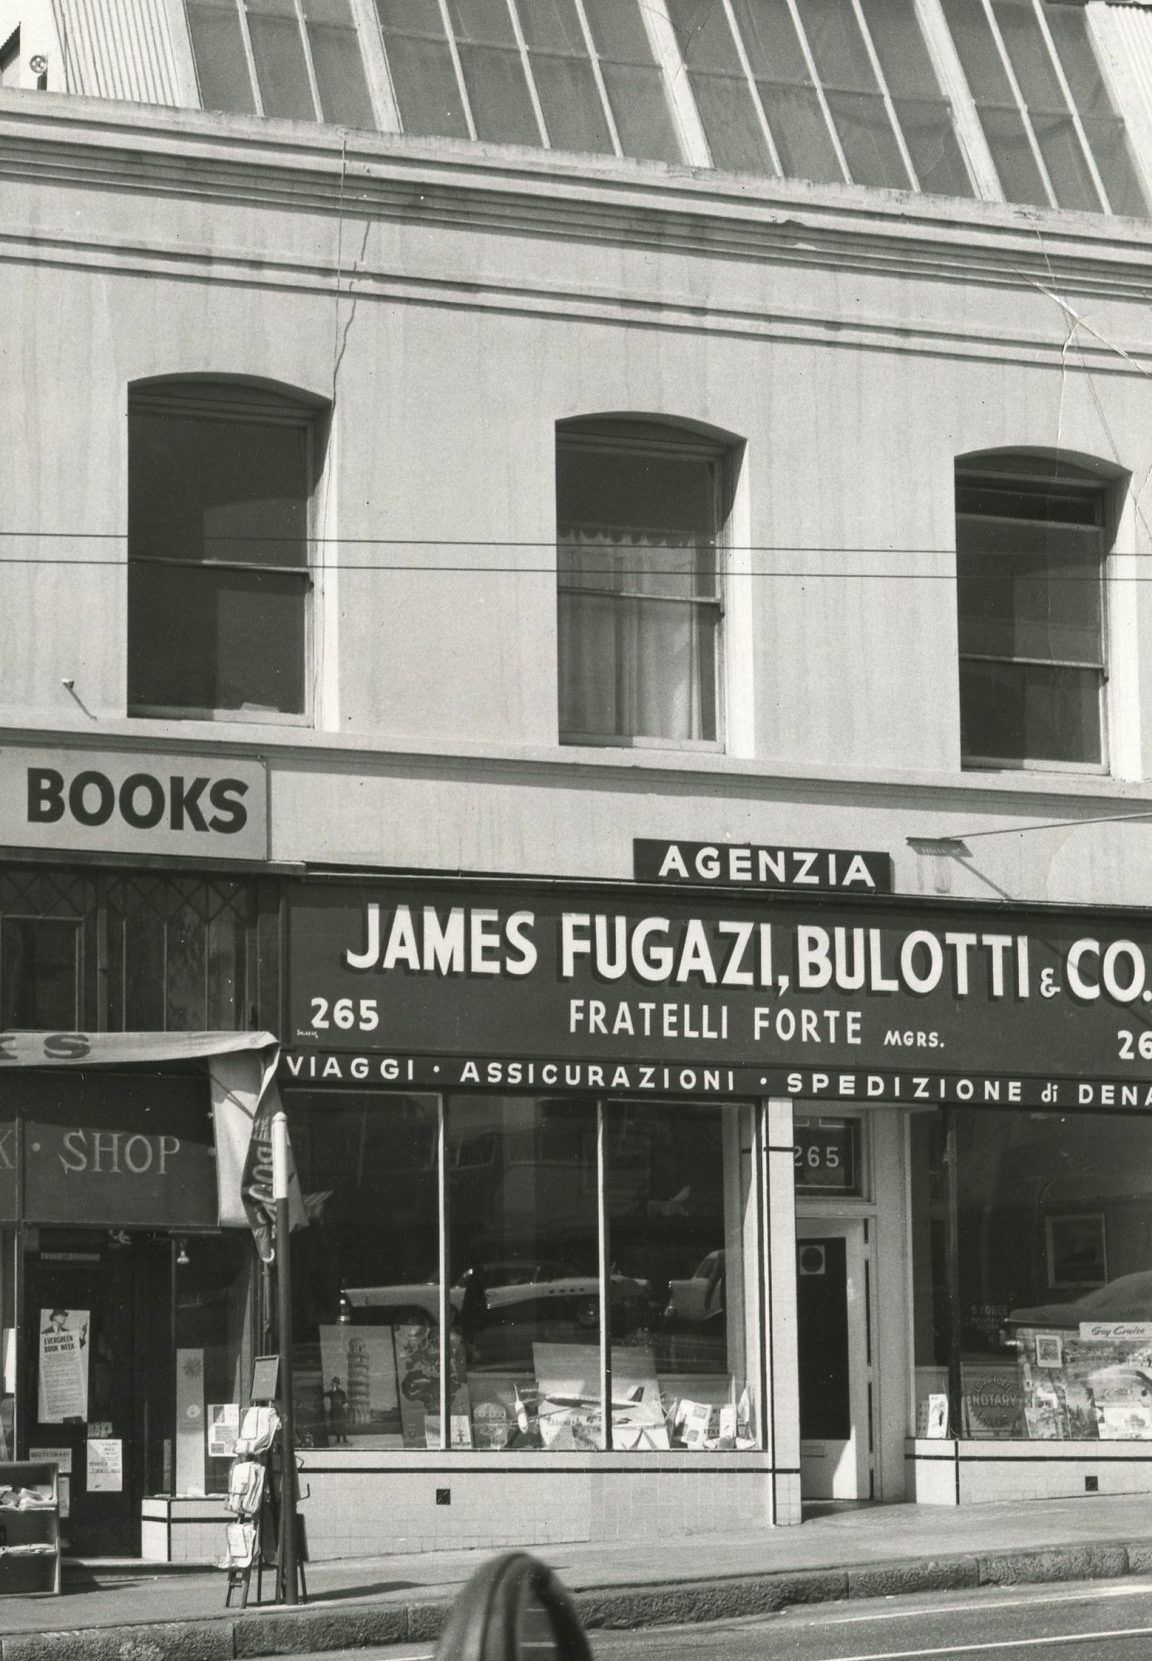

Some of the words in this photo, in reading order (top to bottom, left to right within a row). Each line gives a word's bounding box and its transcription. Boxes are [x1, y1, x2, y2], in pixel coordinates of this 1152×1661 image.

[27, 767, 249, 834] BOOKS
[658, 844, 876, 888] AGENZIA
[346, 902, 538, 976] JAMES
[797, 924, 1030, 998] BULOTTI
[1040, 967, 1061, 998] &
[310, 996, 380, 1032] 265
[569, 999, 728, 1039] FRATELLI
[753, 1006, 862, 1045] FORTE
[883, 1029, 945, 1049] MGRS.
[286, 1056, 414, 1080] VIAGGI
[460, 1060, 734, 1091] ASSICURAZIONI
[787, 1072, 1023, 1102] SPEDIZIONE
[1041, 1082, 1058, 1103] di
[57, 1127, 181, 1175] SHOP
[794, 1145, 840, 1168] 265
[43, 1335, 74, 1346] EVERGREEN
[972, 1393, 1017, 1407] NOTARY
